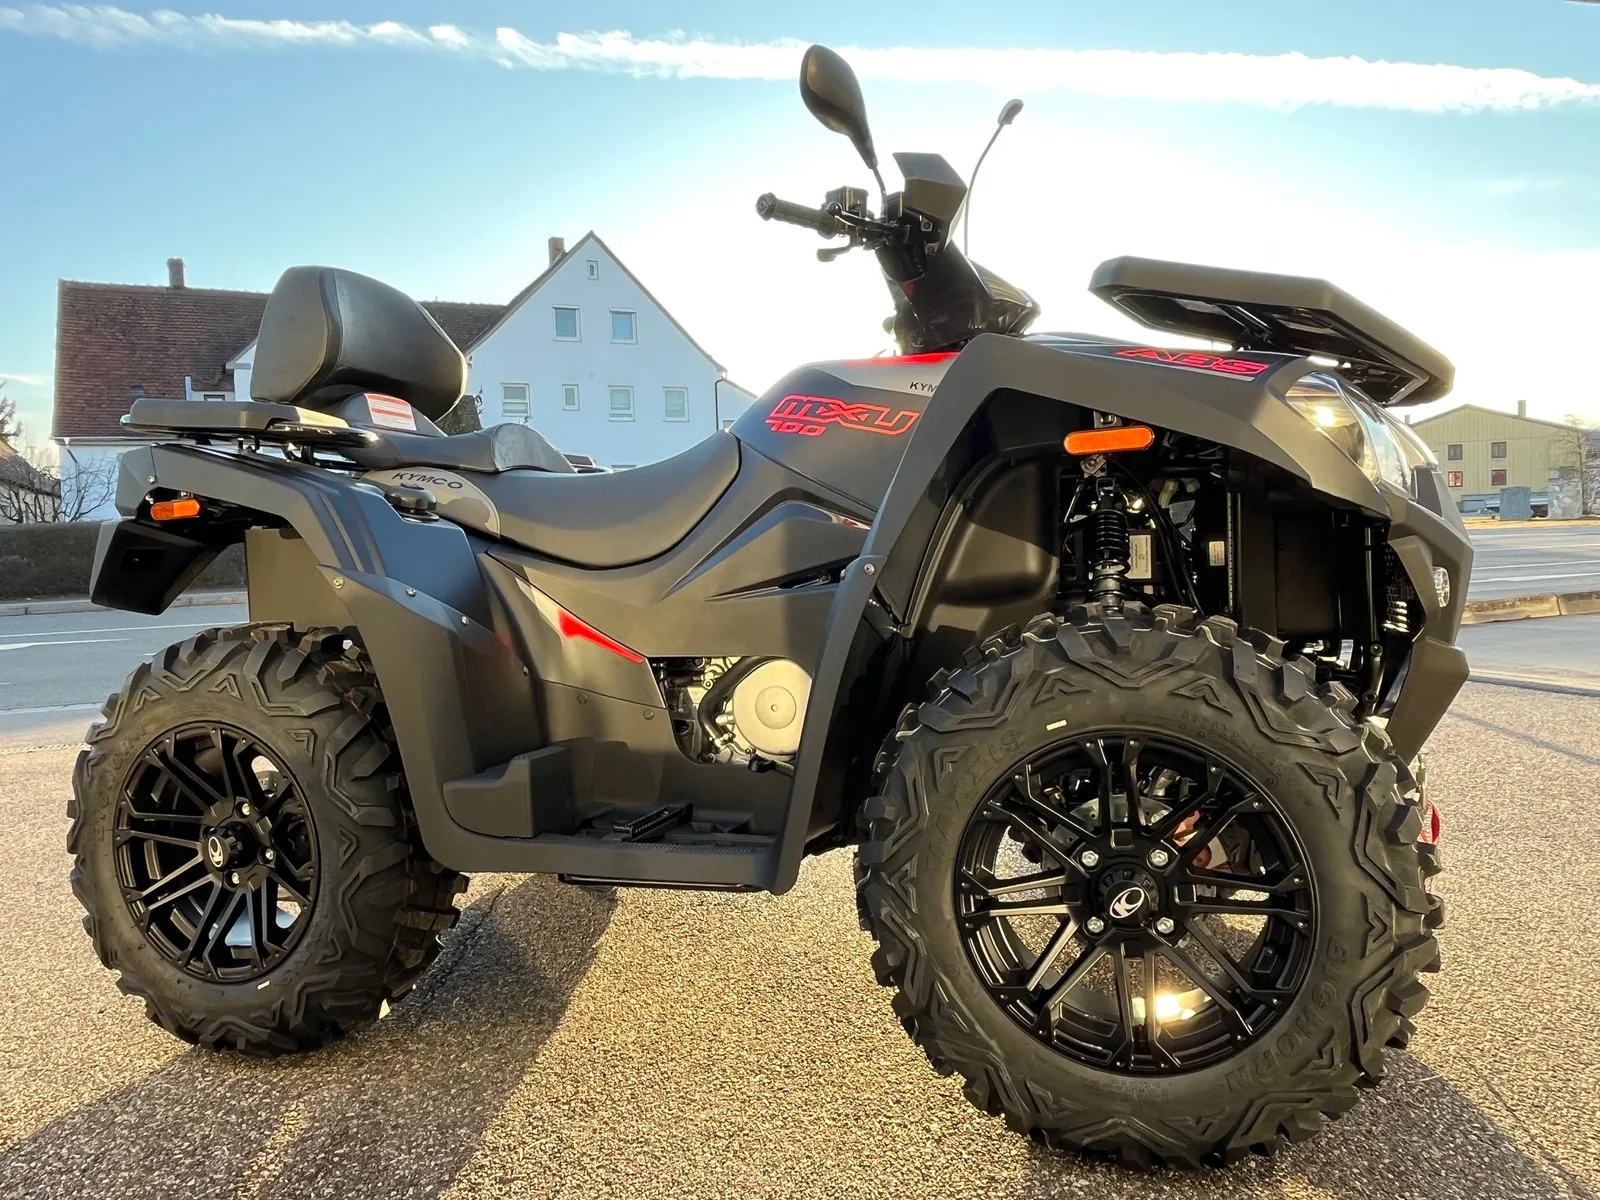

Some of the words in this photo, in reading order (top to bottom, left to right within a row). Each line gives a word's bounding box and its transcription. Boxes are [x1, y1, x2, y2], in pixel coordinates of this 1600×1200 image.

[765, 419, 827, 437] 700
[768, 394, 920, 436] MXU
[392, 472, 463, 489] KYMCO
[1224, 934, 1348, 1092] BIGHORN
